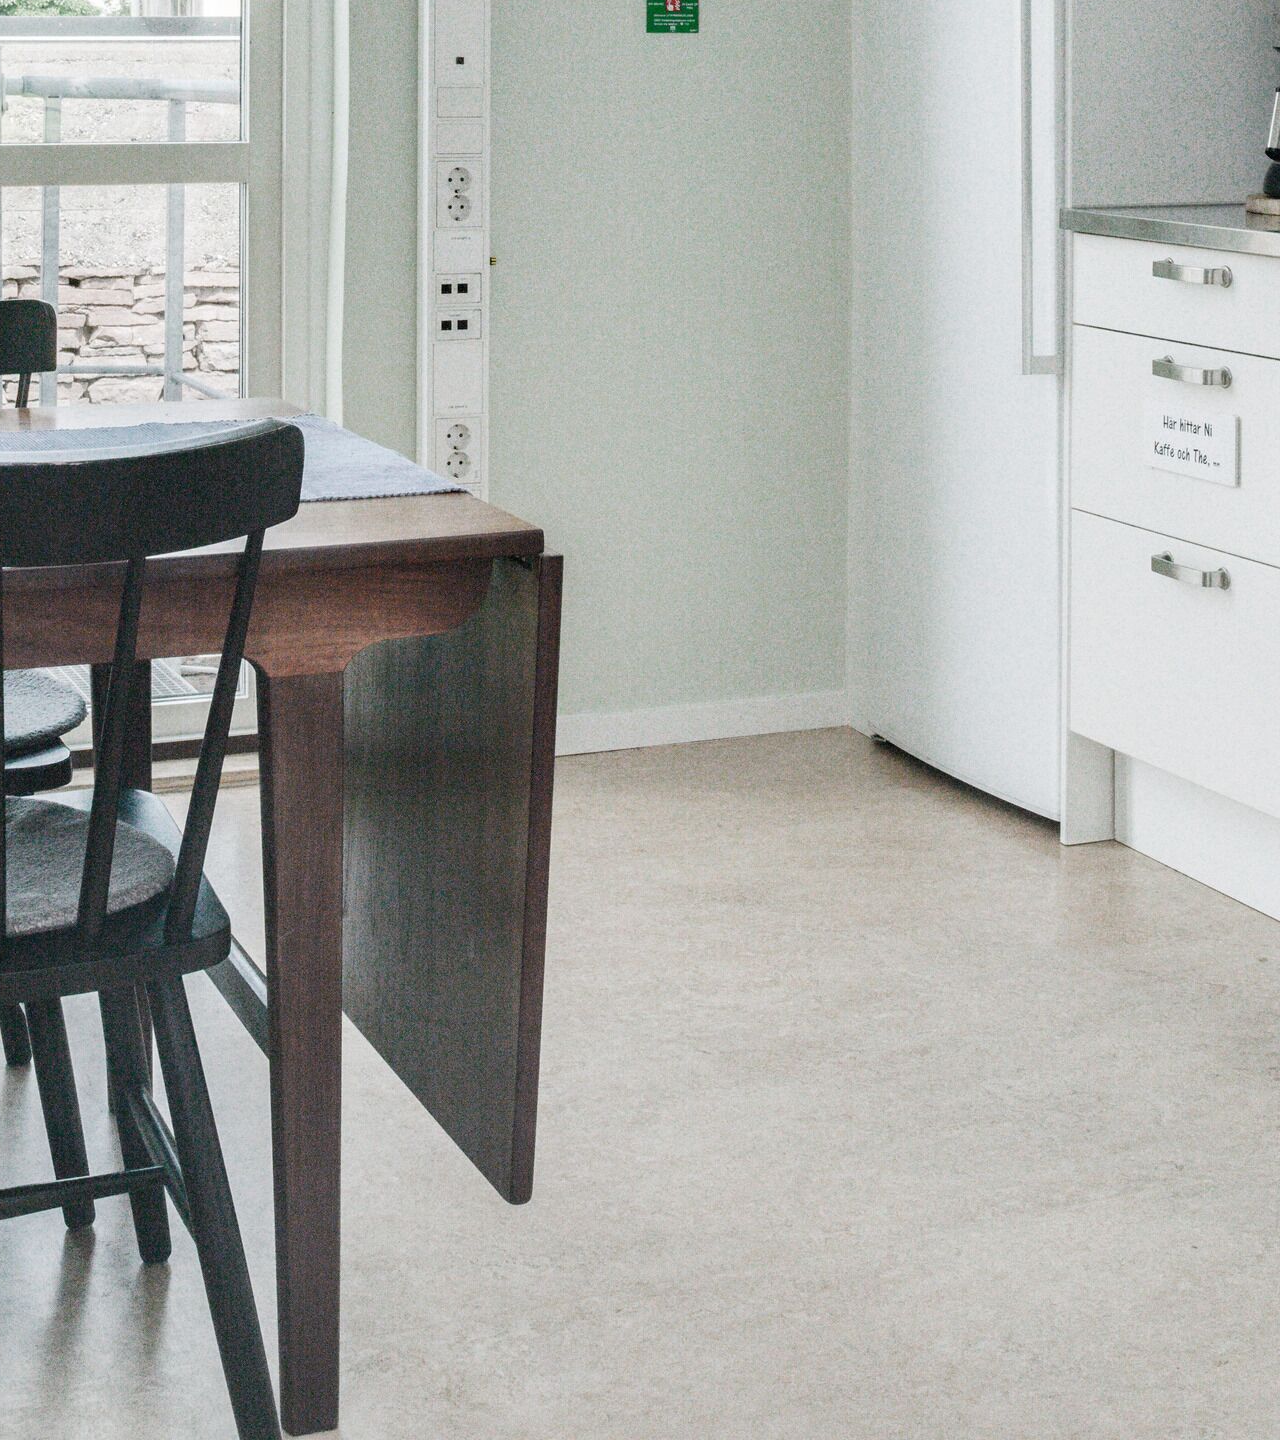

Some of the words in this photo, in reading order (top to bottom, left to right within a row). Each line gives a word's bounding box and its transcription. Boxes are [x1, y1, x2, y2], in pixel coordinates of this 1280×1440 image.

[1179, 418, 1201, 435] hittar
[1204, 422, 1213, 437] Ni
[1153, 441, 1175, 458] Kaffe
[1177, 447, 1191, 461] och
